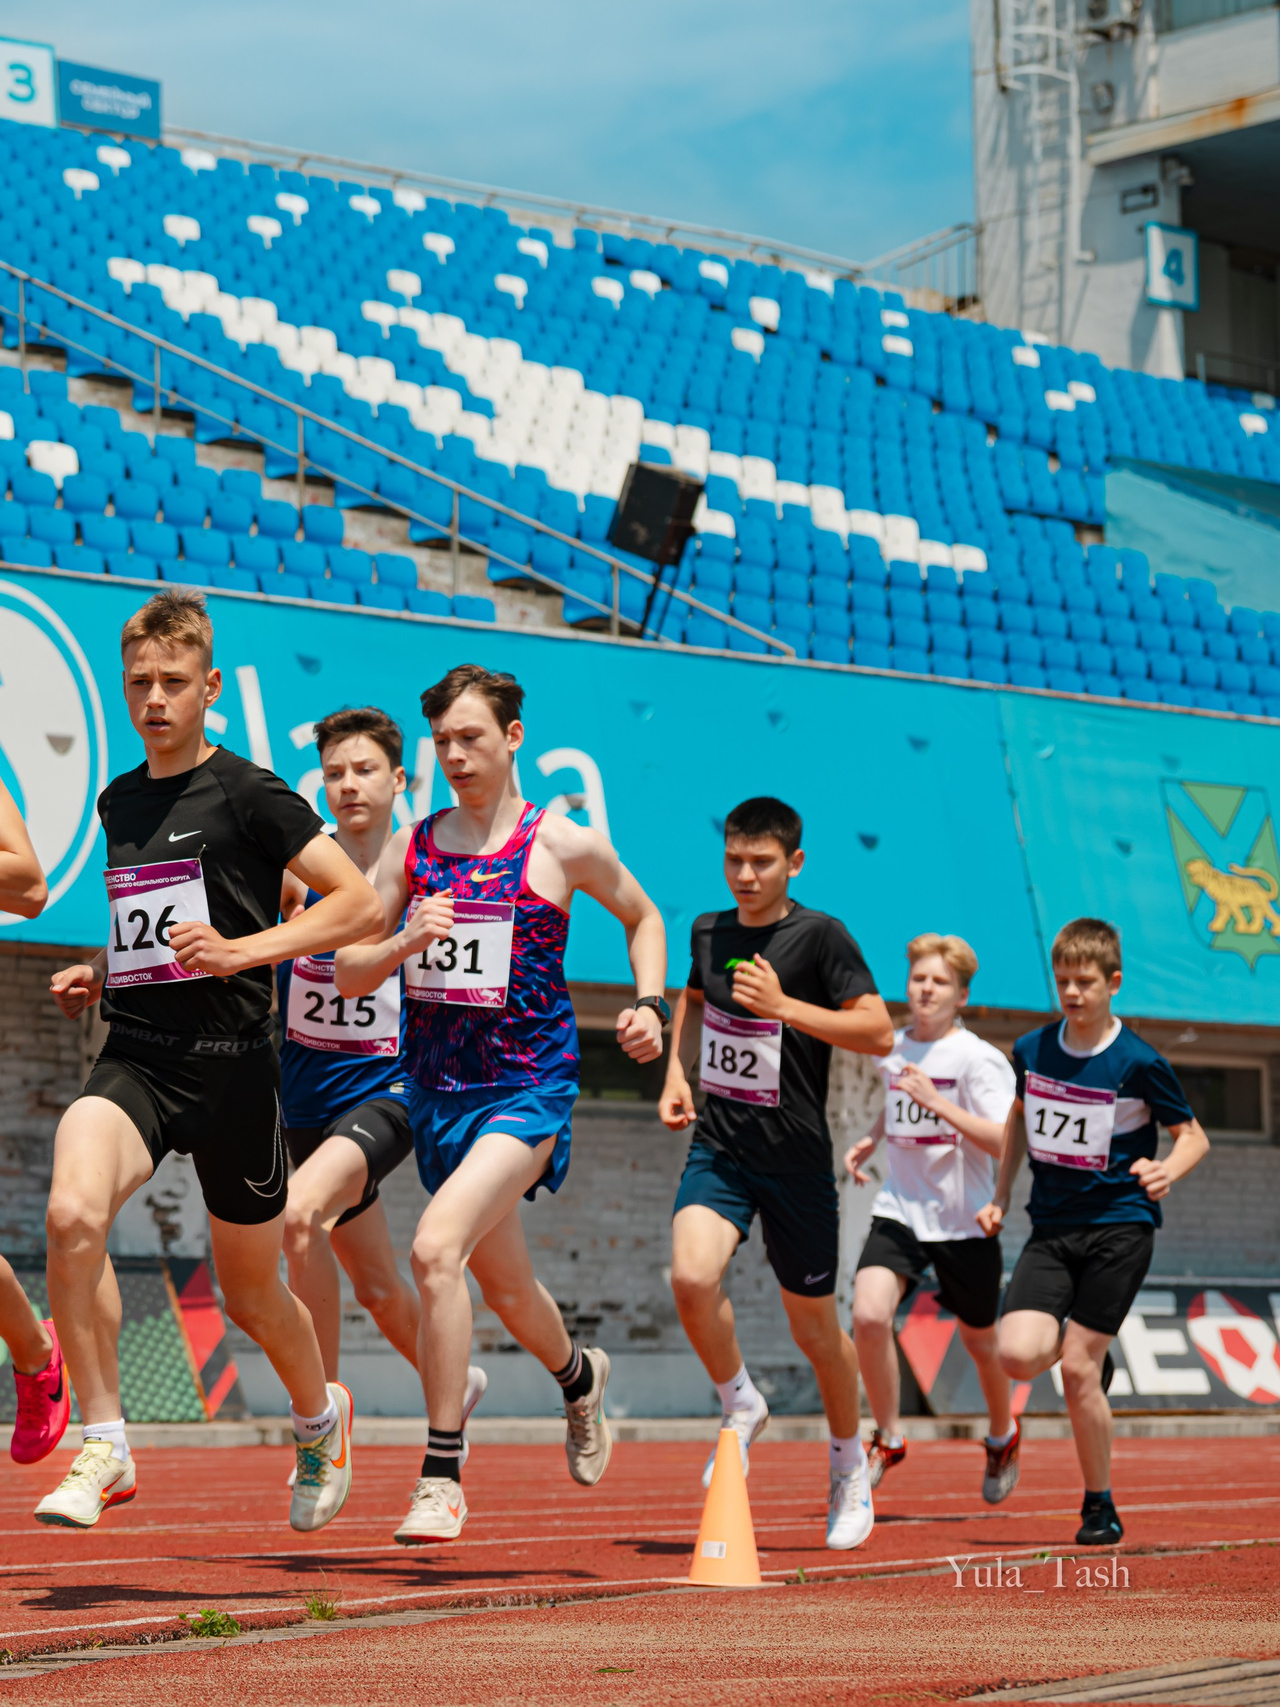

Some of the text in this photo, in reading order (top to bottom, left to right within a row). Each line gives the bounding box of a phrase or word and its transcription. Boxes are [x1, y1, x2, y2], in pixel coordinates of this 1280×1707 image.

[8, 63, 35, 102] 3
[1162, 248, 1185, 286] 4
[133, 877, 169, 887] ФЕДЕРАЛЬНОГО
[170, 874, 190, 882] ОКРУГА
[114, 905, 179, 952] 126
[418, 937, 483, 975] 131
[303, 991, 376, 1028] 215
[111, 1022, 180, 1047] OMBAT
[194, 1040, 249, 1053] PRO
[707, 1040, 758, 1079] 182
[896, 1100, 940, 1126] 104
[1034, 1108, 1088, 1145] 171
